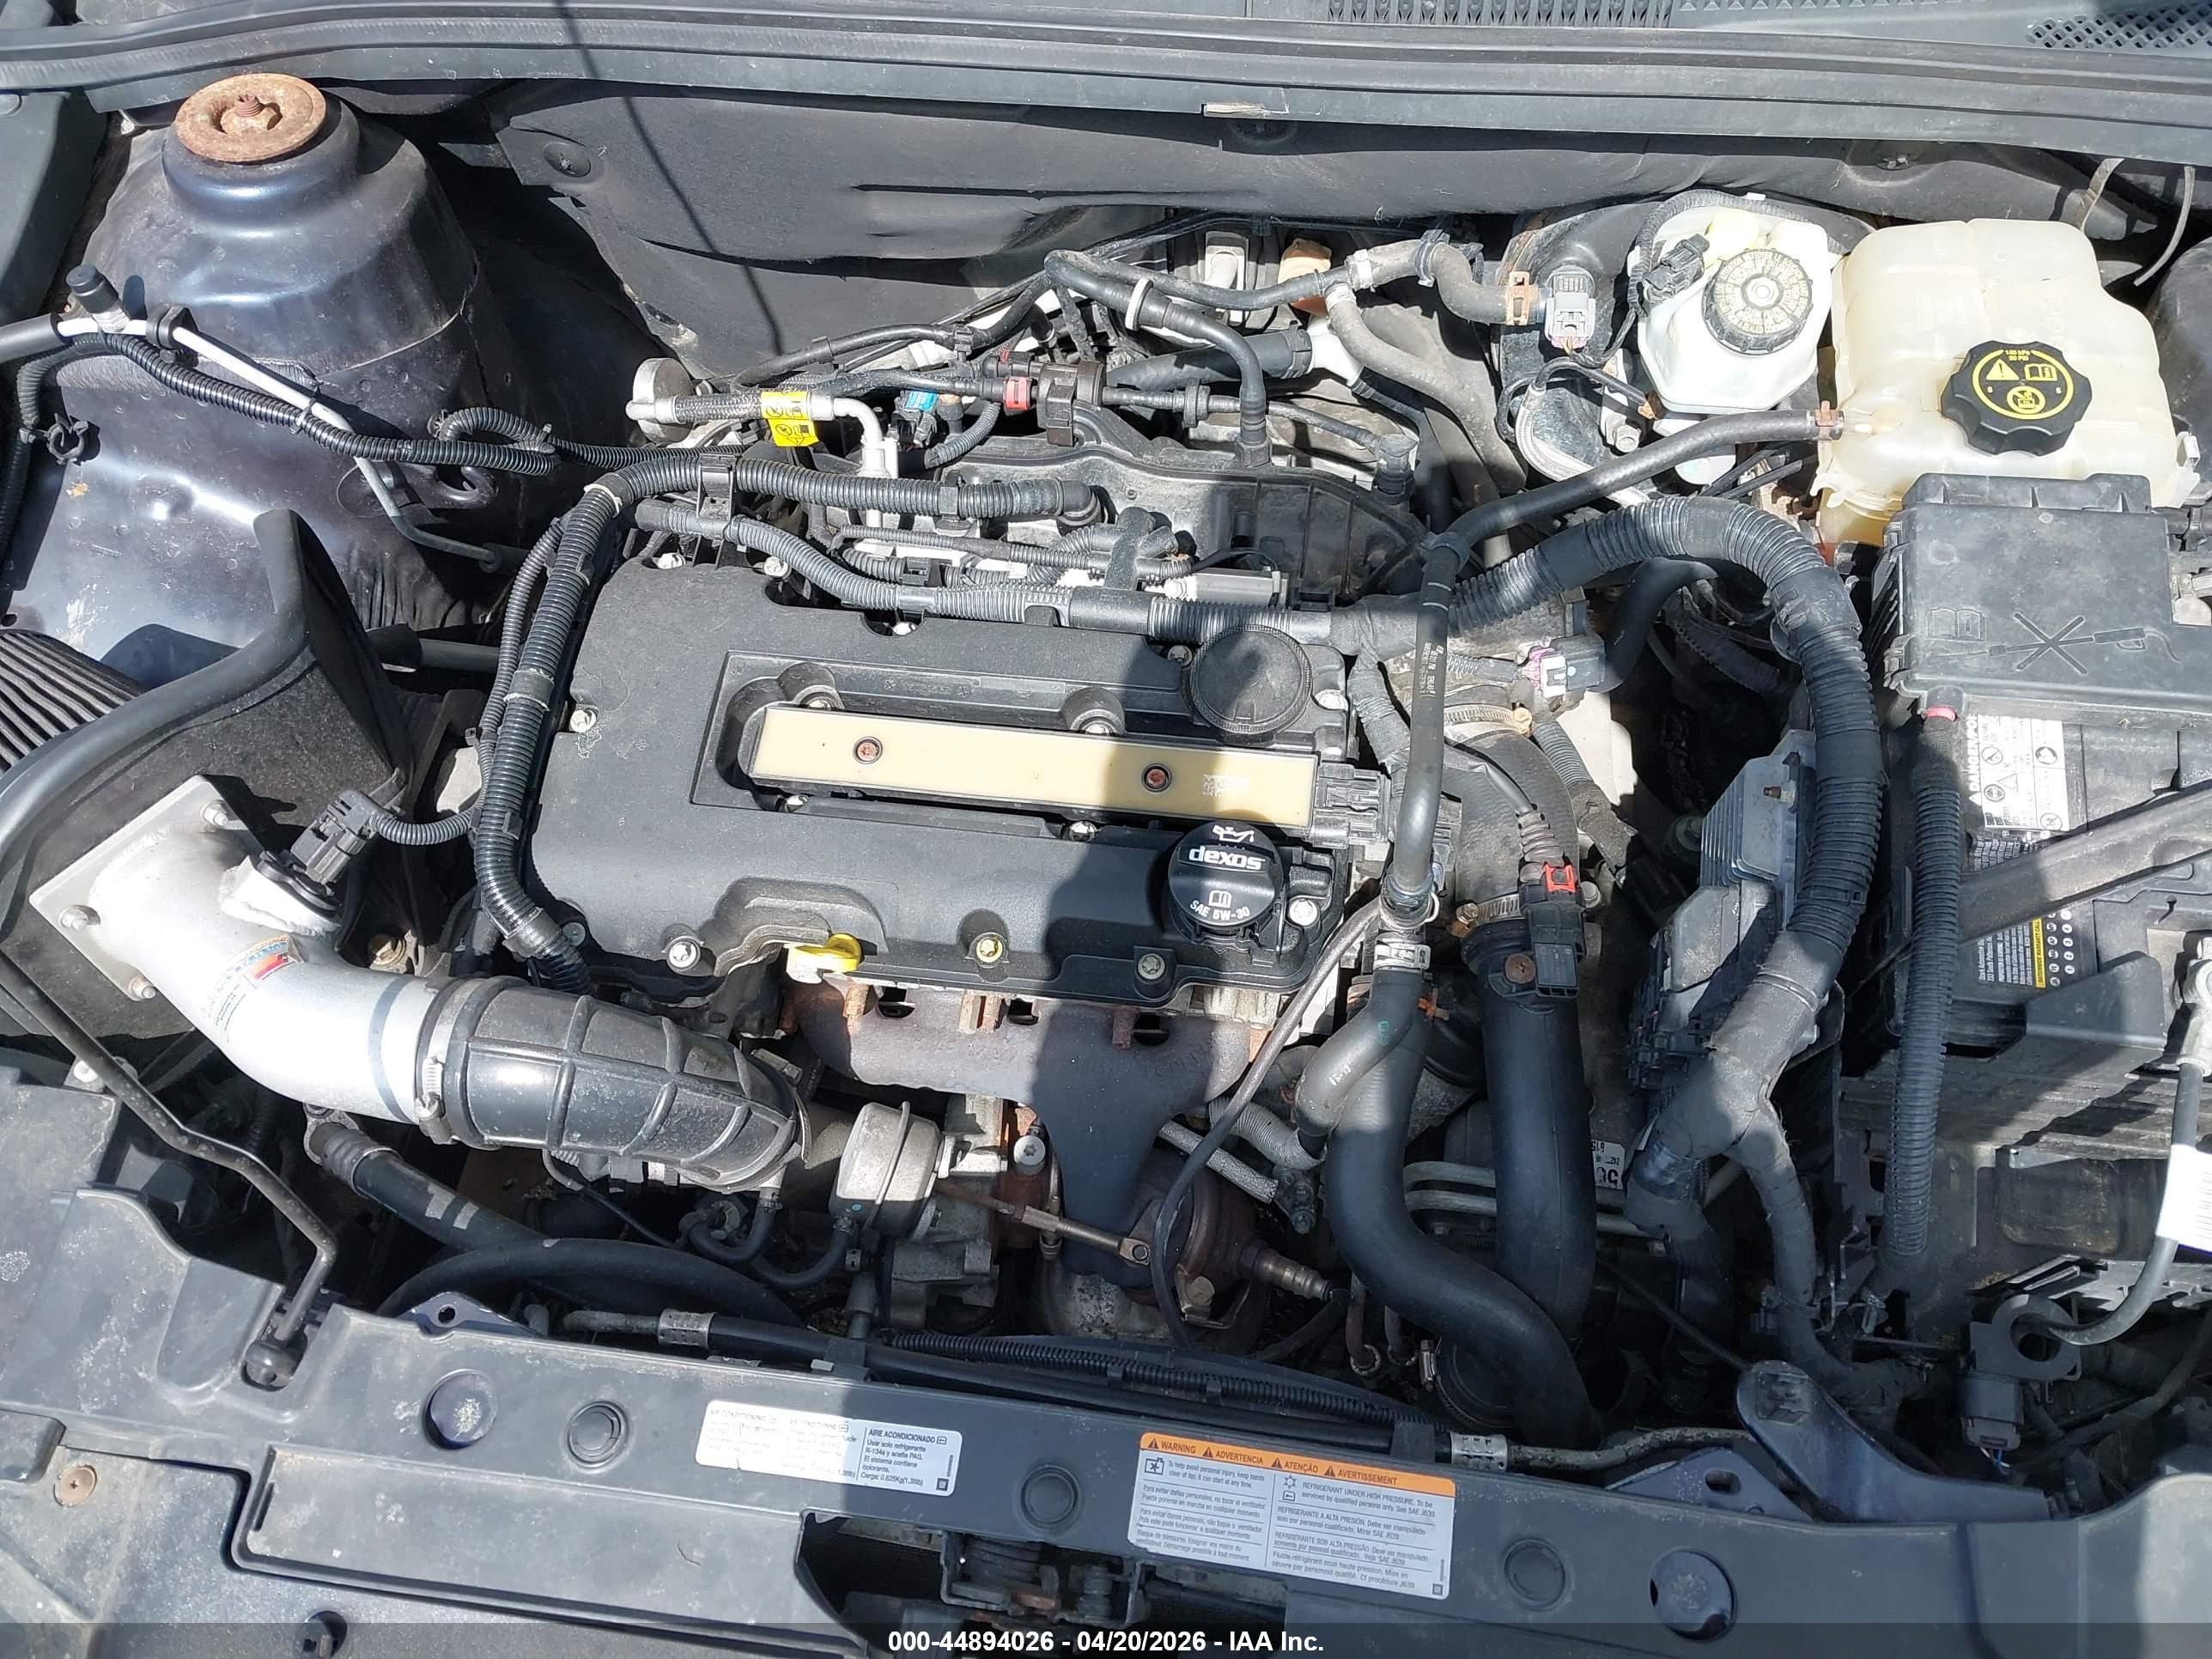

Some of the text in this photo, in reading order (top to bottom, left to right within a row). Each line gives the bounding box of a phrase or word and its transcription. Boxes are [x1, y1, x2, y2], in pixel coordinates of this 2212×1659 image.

[1967, 714, 1980, 792] DANGER/POI
[1188, 846, 1263, 870] dexos
[1190, 900, 1250, 921] SAE 5W-30
[868, 1428, 935, 1443] AIRE ACONDICIONADO
[893, 1443, 926, 1453] refrigerante
[1160, 1441, 1196, 1453] WARNING
[893, 1459, 917, 1468] contiene
[1215, 1449, 1263, 1464] ADVERTENCIA
[1174, 1461, 1185, 1470] help
[1185, 1462, 1200, 1471] avoid
[1200, 1465, 1220, 1475] personal
[1237, 1471, 1249, 1480] keep
[1284, 1459, 1318, 1474] ATENÇÃO
[1338, 1468, 1397, 1486] AVERTISSEMENT
[1301, 1490, 1324, 1499] serviced
[1325, 1493, 1333, 1503] by
[1334, 1495, 1358, 1506] qualified
[1358, 1500, 1381, 1510] persons
[1302, 1481, 1343, 1494] REFRIGERANT
[1344, 1488, 1365, 1498] UNDER
[1366, 1492, 1381, 1500] HIGH
[1382, 1493, 1415, 1505] PRESSURE.
[1158, 1498, 1177, 1506] ponerse
[1186, 1501, 1205, 1510] marcha
[1212, 1505, 1236, 1516] cualquier
[1161, 1519, 1174, 1528] pode
[1204, 1526, 1225, 1536] qualquer
[1216, 1520, 1231, 1529] toque
[1276, 1514, 1288, 1522] solo
[1298, 1517, 1323, 1529] personal
[1356, 1527, 1371, 1535] Mirar
[1277, 1505, 1320, 1518] REFRIGERANTE
[1325, 1512, 1340, 1522] ALTA
[1367, 1519, 1382, 1528] Debe
[1392, 1523, 1425, 1537] manipulado
[1273, 1538, 1297, 1548] somente
[1308, 1544, 1329, 1554] pessoal
[1274, 1530, 1315, 1543] REFRIGERANTE
[1316, 1537, 1328, 1546] SOB
[1328, 1539, 1342, 1547] ALTA
[1371, 1546, 1385, 1554] Deve
[1396, 1549, 1428, 1563] manipulado
[1272, 1551, 1291, 1560] Fluide
[1339, 1561, 1355, 1571] haute
[1384, 1569, 1399, 1577] Mise
